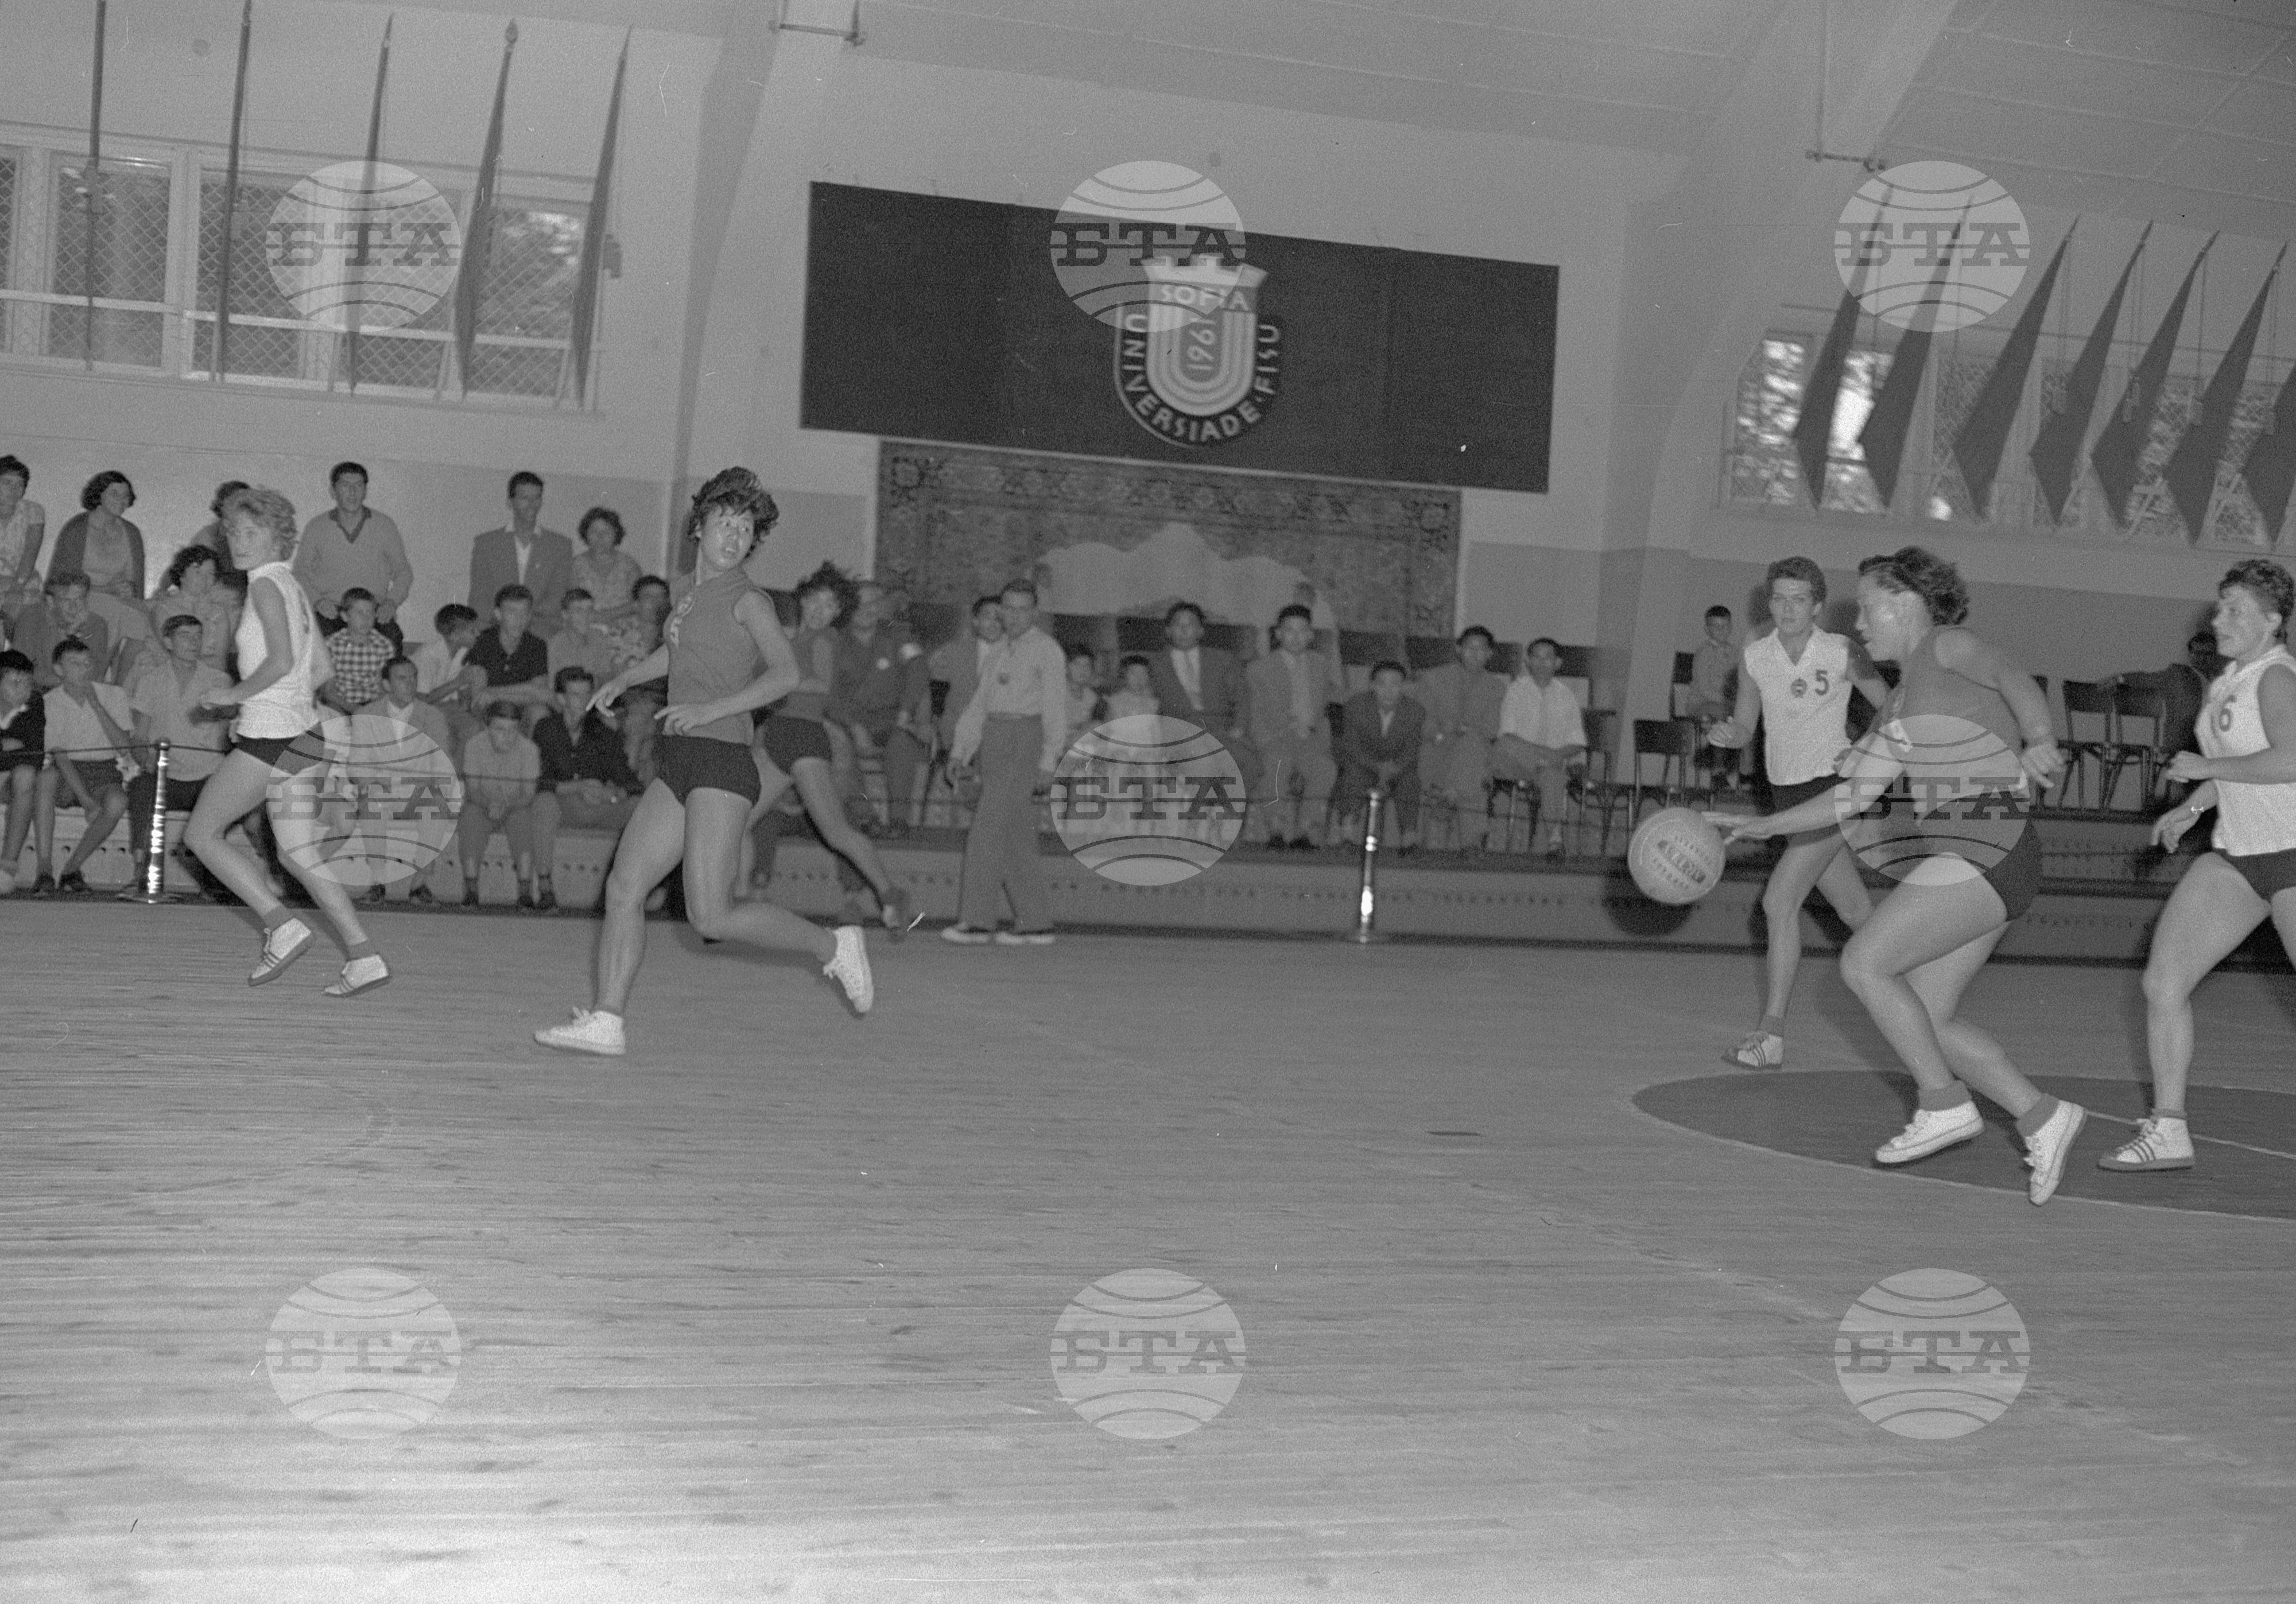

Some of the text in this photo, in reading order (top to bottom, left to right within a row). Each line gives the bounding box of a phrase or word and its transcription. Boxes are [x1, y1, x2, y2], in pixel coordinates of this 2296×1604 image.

[1161, 285, 1250, 310] SOFIA
[1186, 318, 1216, 371] 1961
[1122, 313, 1280, 441] UNIVERSIADE FISU
[1814, 669, 1829, 696] 5
[2219, 694, 2237, 732] 6
